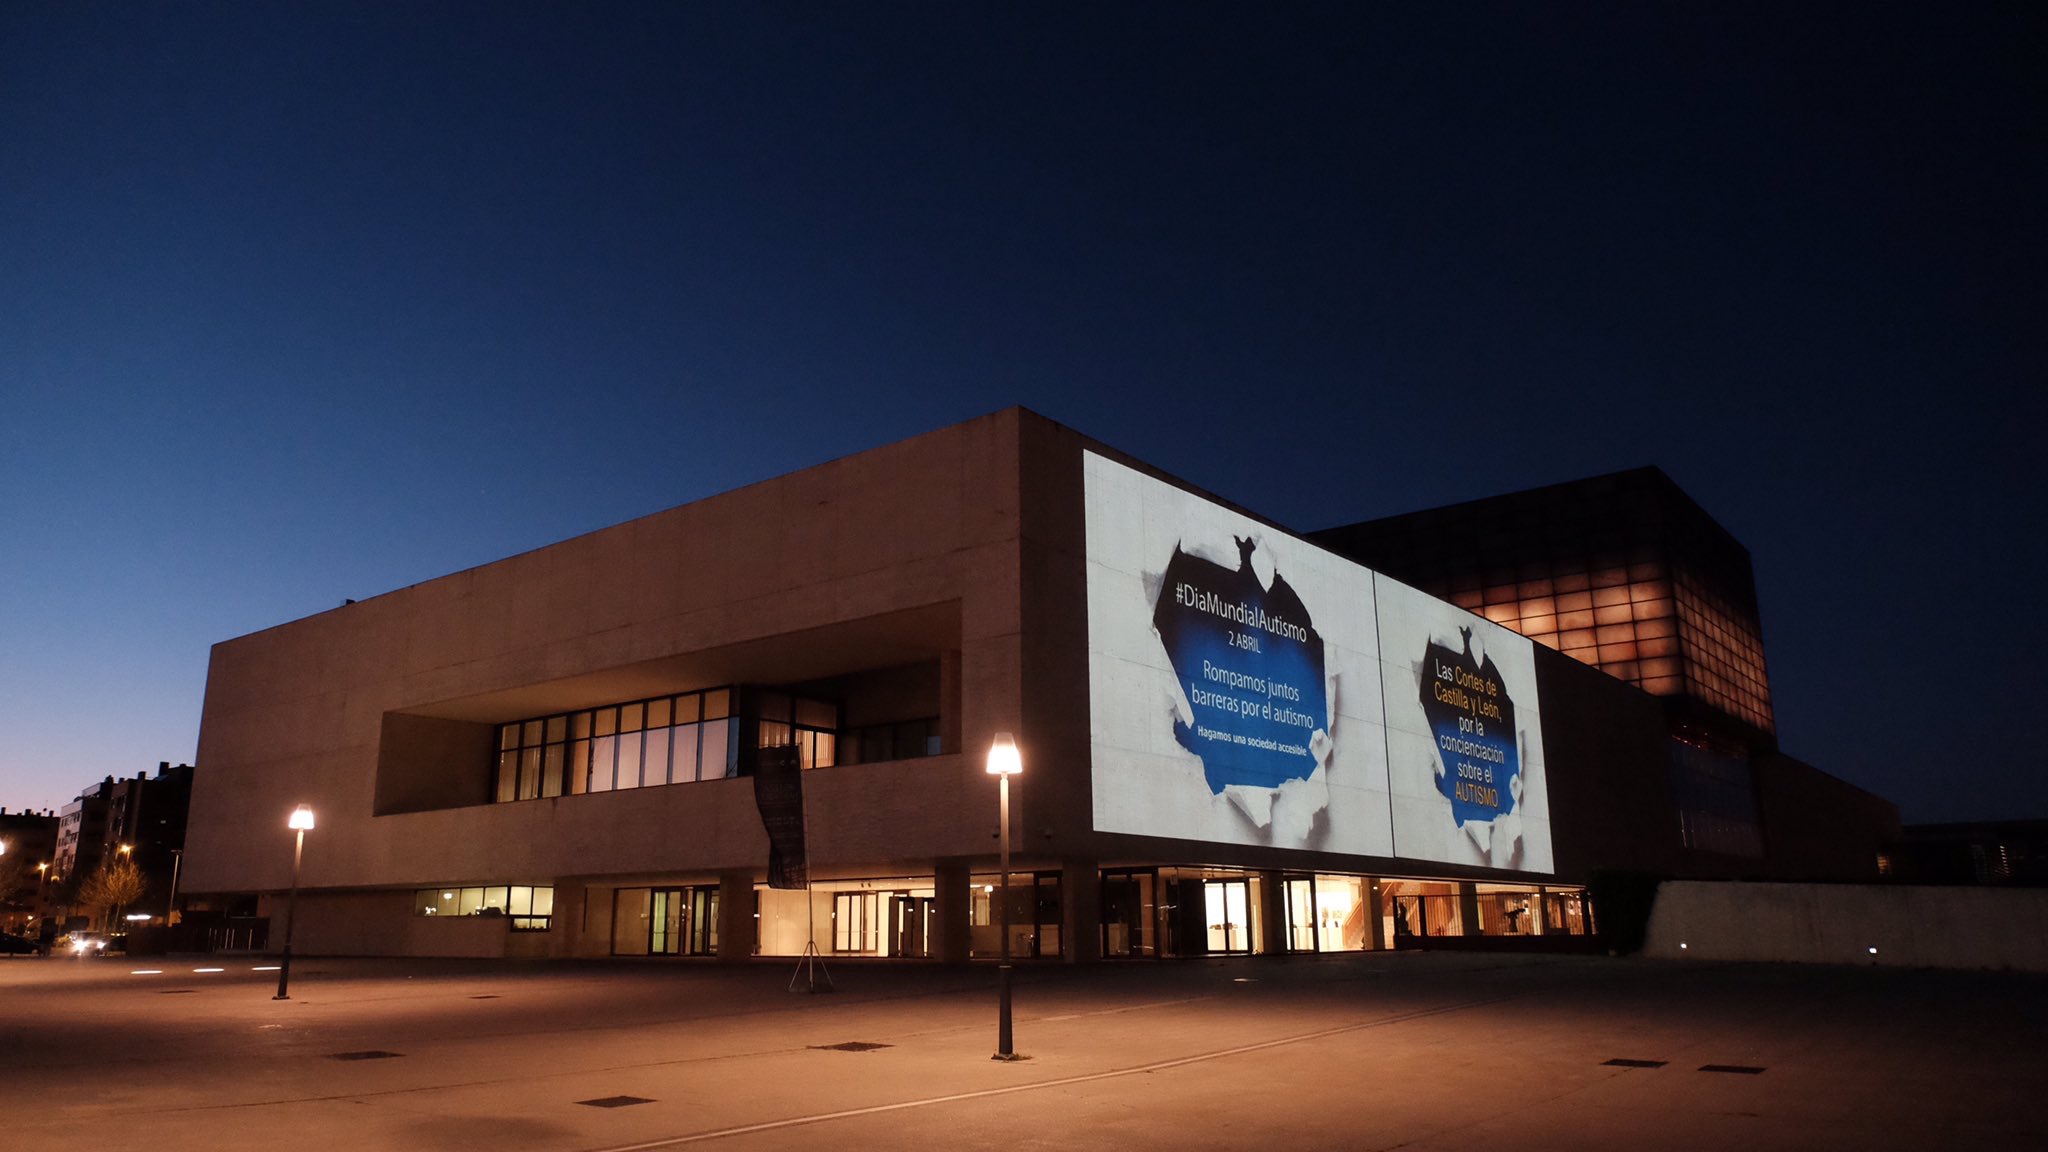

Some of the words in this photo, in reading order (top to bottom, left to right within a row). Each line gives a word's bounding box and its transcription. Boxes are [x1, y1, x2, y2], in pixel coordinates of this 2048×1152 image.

[1228, 631, 1234, 645] 2
[1236, 634, 1261, 654] ABRIL
[1203, 660, 1265, 691] Rompamos
[1267, 677, 1299, 701] juntos
[1436, 658, 1453, 682] Las
[1455, 666, 1484, 693] Cortes
[1486, 678, 1496, 696] de
[1192, 683, 1239, 713] barreras
[1242, 700, 1259, 718] por
[1262, 702, 1271, 719] el
[1274, 706, 1314, 728] autismo
[1434, 681, 1469, 709] Castilla
[1470, 698, 1476, 716] y
[1478, 697, 1502, 723] León,
[1198, 726, 1231, 743] Hagamos
[1233, 733, 1246, 745] una
[1248, 735, 1277, 751] sociedad
[1278, 741, 1307, 756] accesible
[1459, 716, 1474, 735] por
[1476, 717, 1484, 736] la
[1441, 733, 1504, 764] concienciación
[1457, 761, 1483, 781] sobre
[1484, 766, 1492, 783] el
[1455, 782, 1498, 808] AUTISMO
